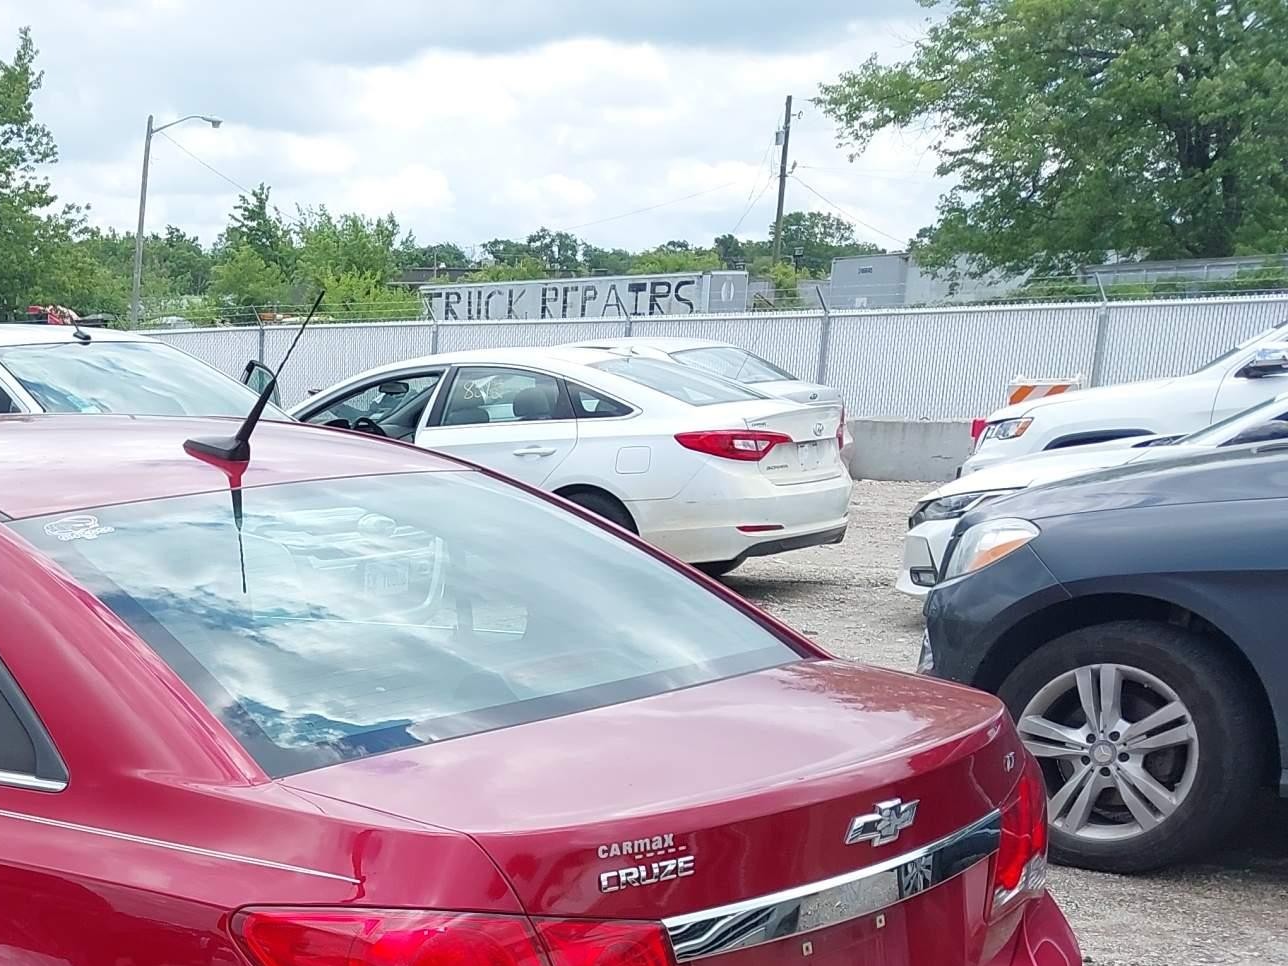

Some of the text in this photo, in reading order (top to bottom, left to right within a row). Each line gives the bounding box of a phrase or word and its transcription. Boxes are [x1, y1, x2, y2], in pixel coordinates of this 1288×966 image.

[424, 280, 696, 320] TRUCK REPAIRS
[600, 855, 695, 893] CRUZE
